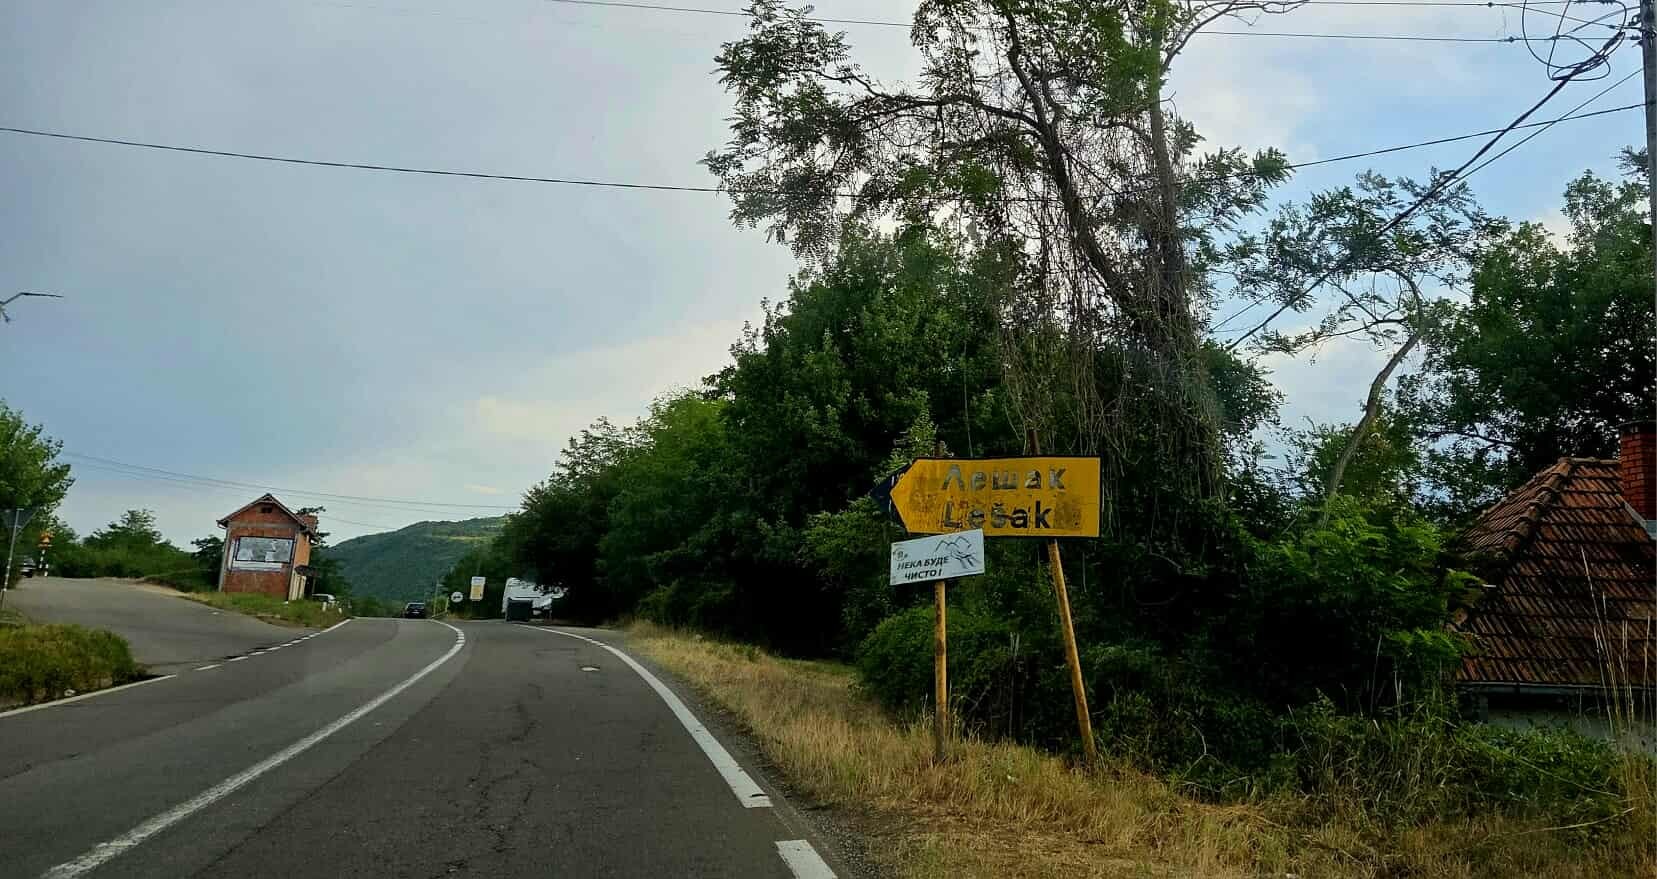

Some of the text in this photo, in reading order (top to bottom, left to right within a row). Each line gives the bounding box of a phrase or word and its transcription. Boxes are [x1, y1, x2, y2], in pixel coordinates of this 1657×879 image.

[942, 464, 1066, 490] Лешак
[943, 500, 1052, 529] Lešak
[897, 556, 950, 570] НЕКА БУДЕ
